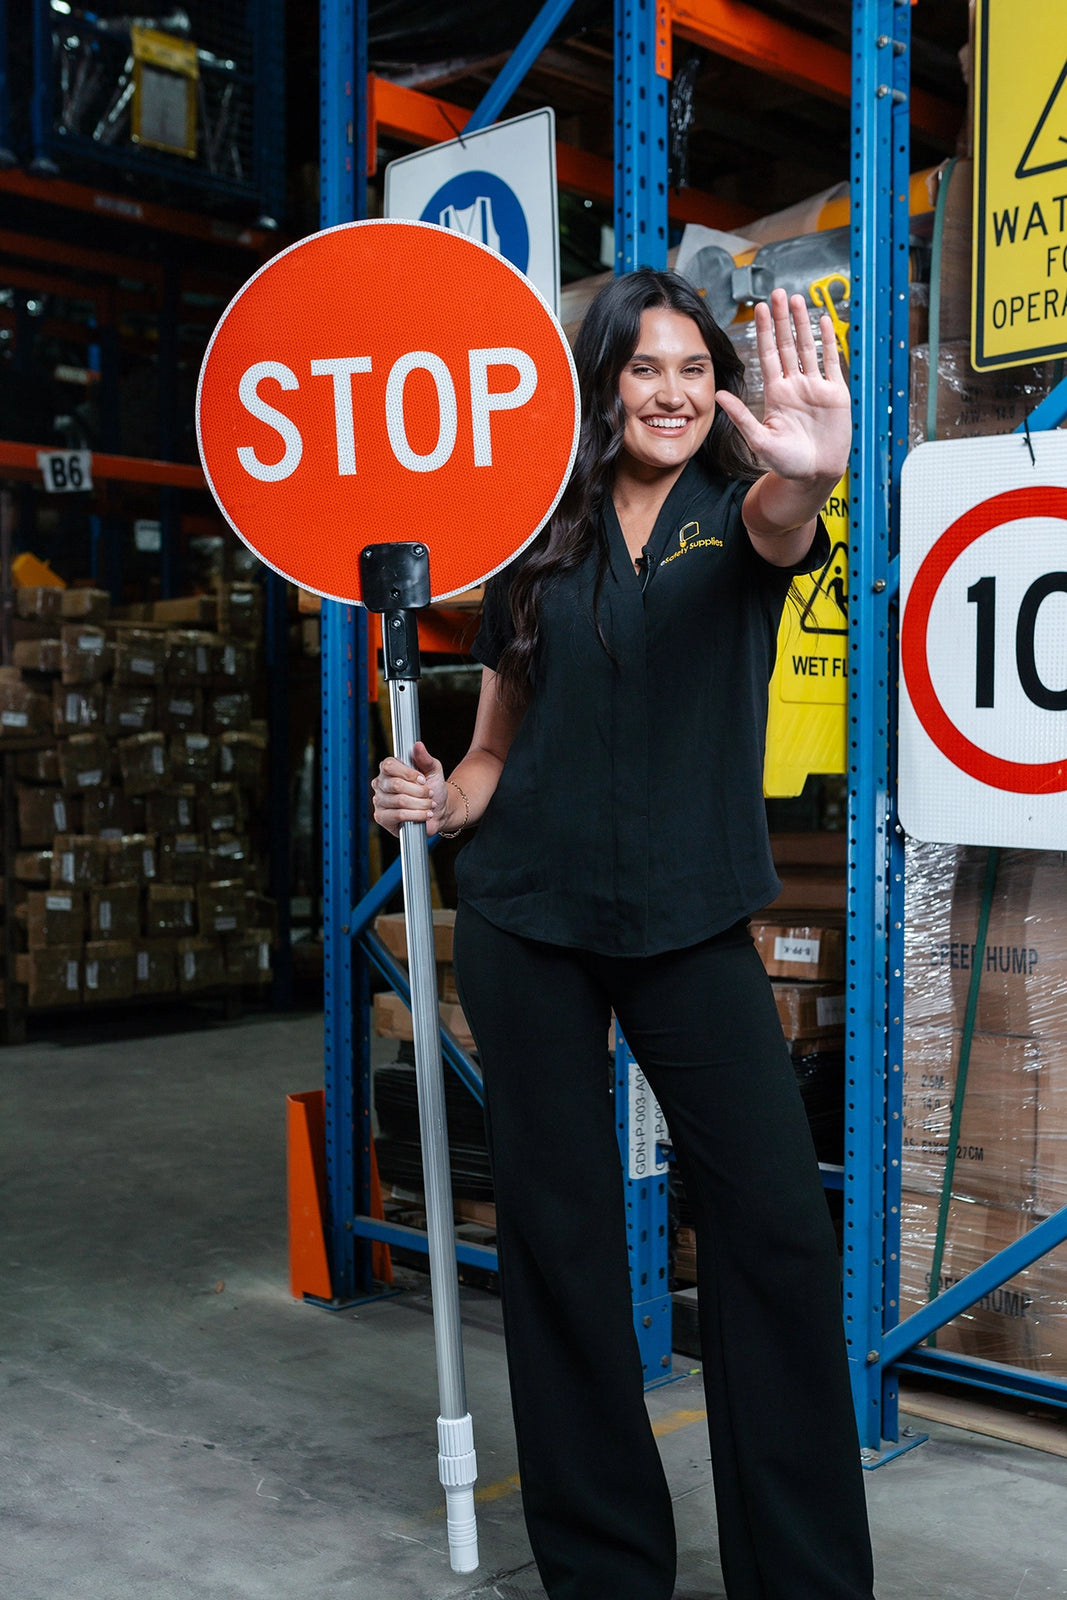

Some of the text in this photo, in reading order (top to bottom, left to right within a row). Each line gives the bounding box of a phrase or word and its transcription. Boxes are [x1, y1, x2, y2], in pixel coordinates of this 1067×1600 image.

[236, 346, 538, 482] STOP
[50, 456, 83, 487] B6
[967, 570, 1067, 712] 10
[792, 655, 829, 677] WET
[930, 943, 1038, 974] SPEE HUMP
